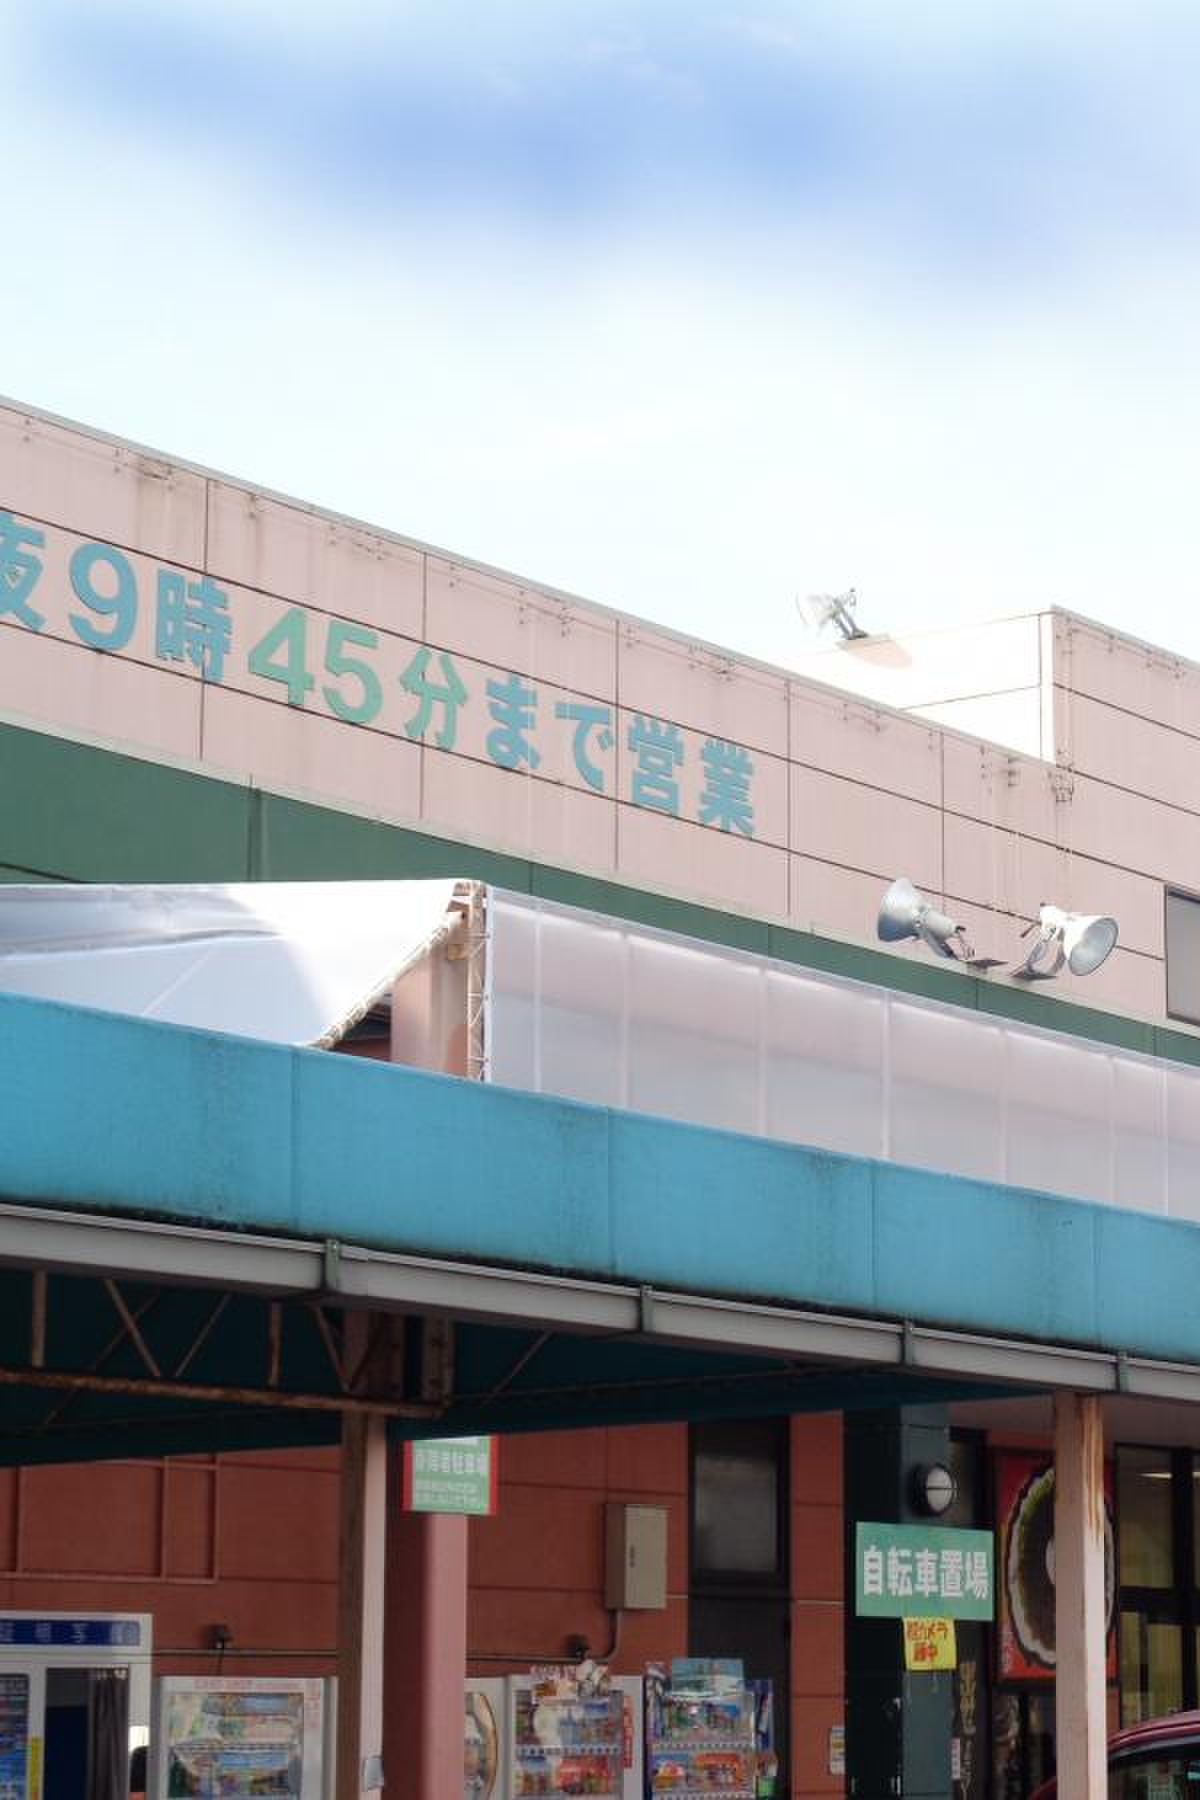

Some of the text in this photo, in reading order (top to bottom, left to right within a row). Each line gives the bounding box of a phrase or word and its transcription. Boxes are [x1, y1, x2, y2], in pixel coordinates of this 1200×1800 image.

[863, 1546, 988, 1598] 自転車置場
